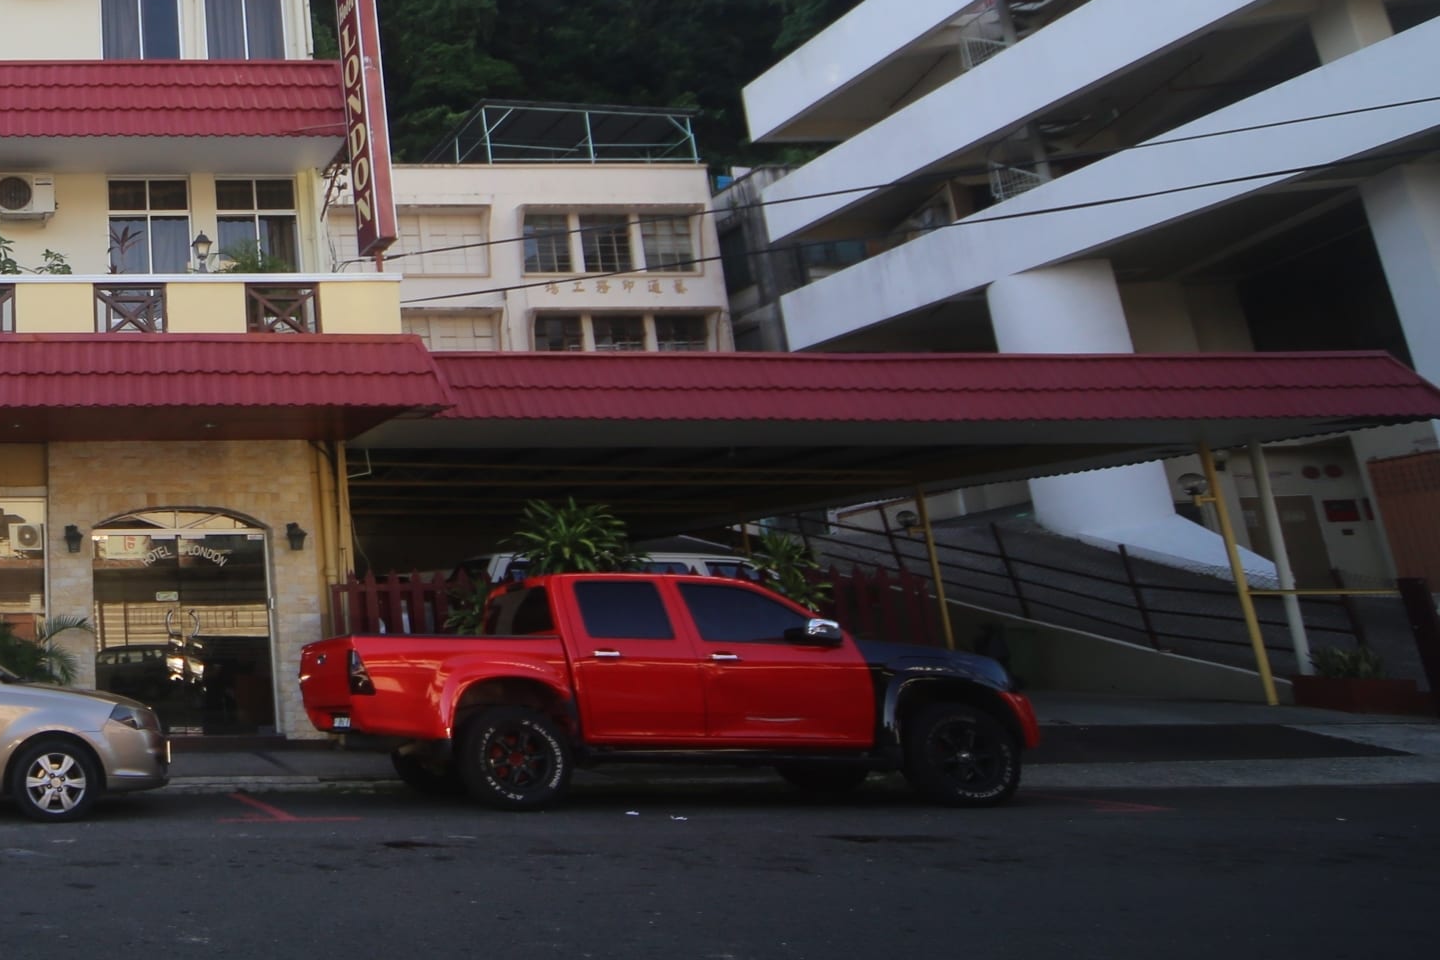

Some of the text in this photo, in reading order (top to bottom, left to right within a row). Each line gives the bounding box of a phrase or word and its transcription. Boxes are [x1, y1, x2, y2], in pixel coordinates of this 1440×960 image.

[342, 24, 372, 230] LONDON
[142, 545, 228, 567] HOTEL LONDON
